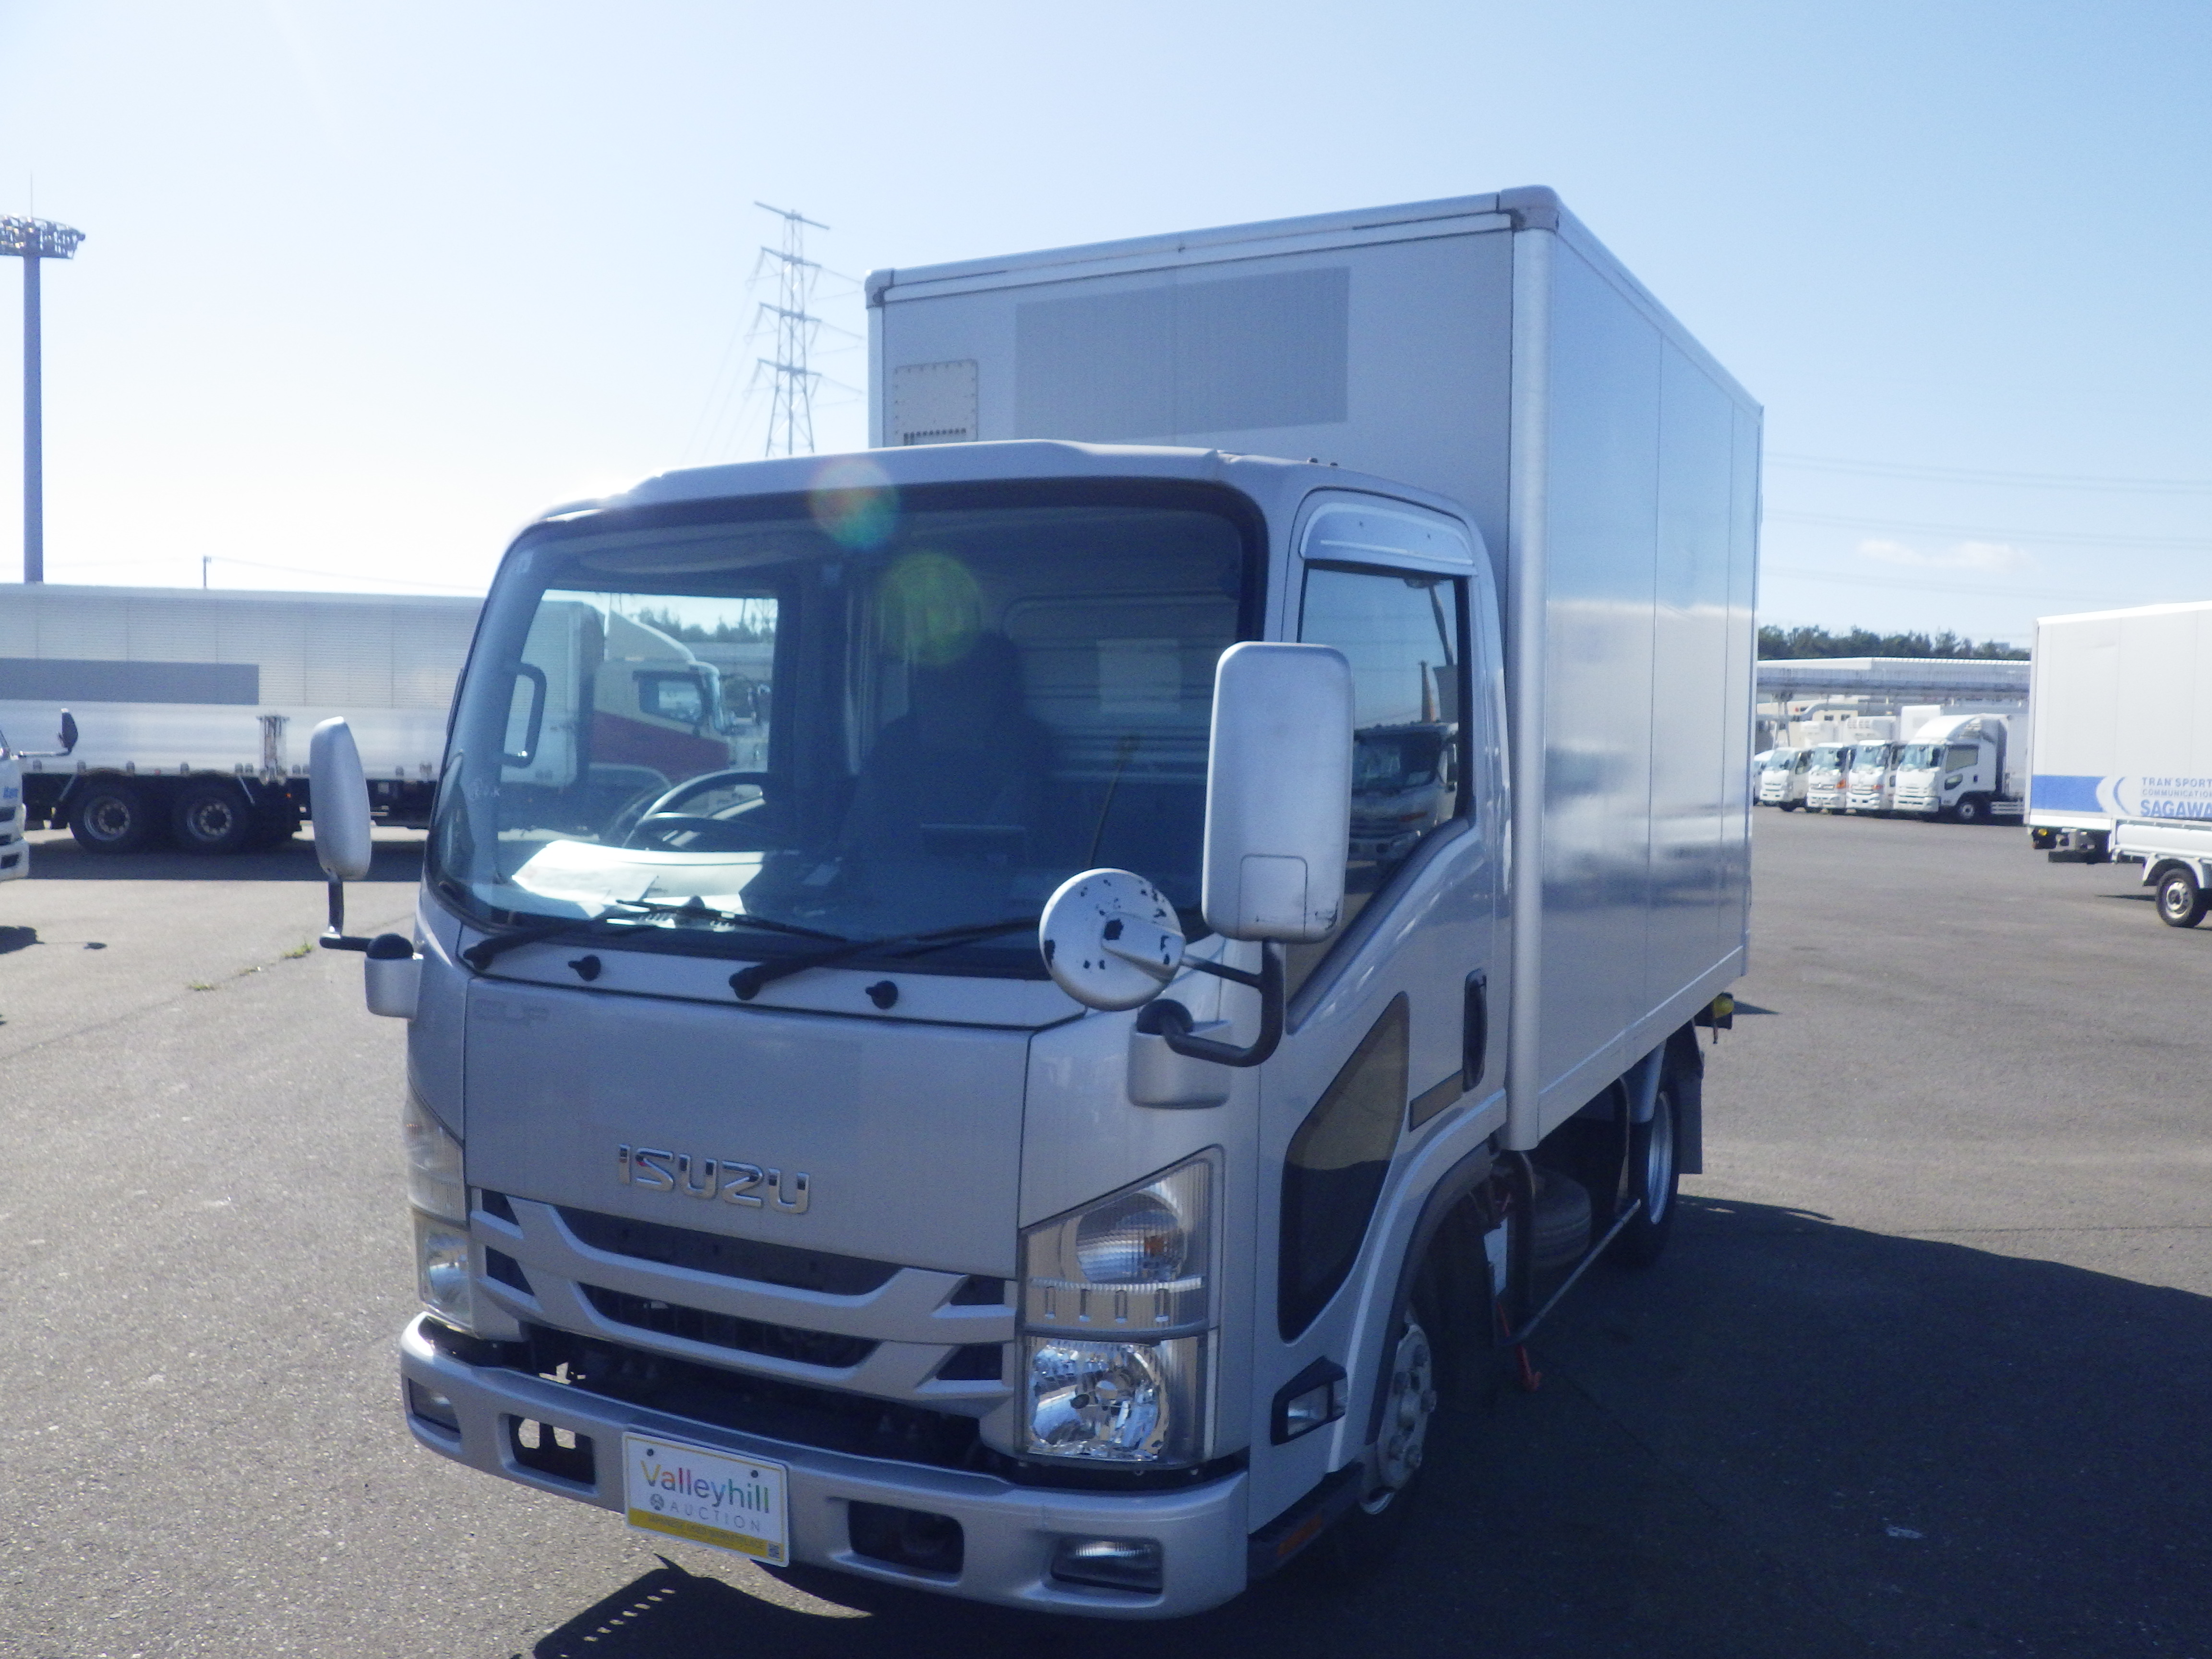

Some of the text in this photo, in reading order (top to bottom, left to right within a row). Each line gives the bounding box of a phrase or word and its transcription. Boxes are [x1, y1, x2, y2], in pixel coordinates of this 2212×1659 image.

[2140, 799, 2212, 817] SAGAWA
[619, 1143, 810, 1214] ISUZU
[640, 1460, 769, 1513] Valleyhill
[670, 1501, 760, 1532] AUCTION
